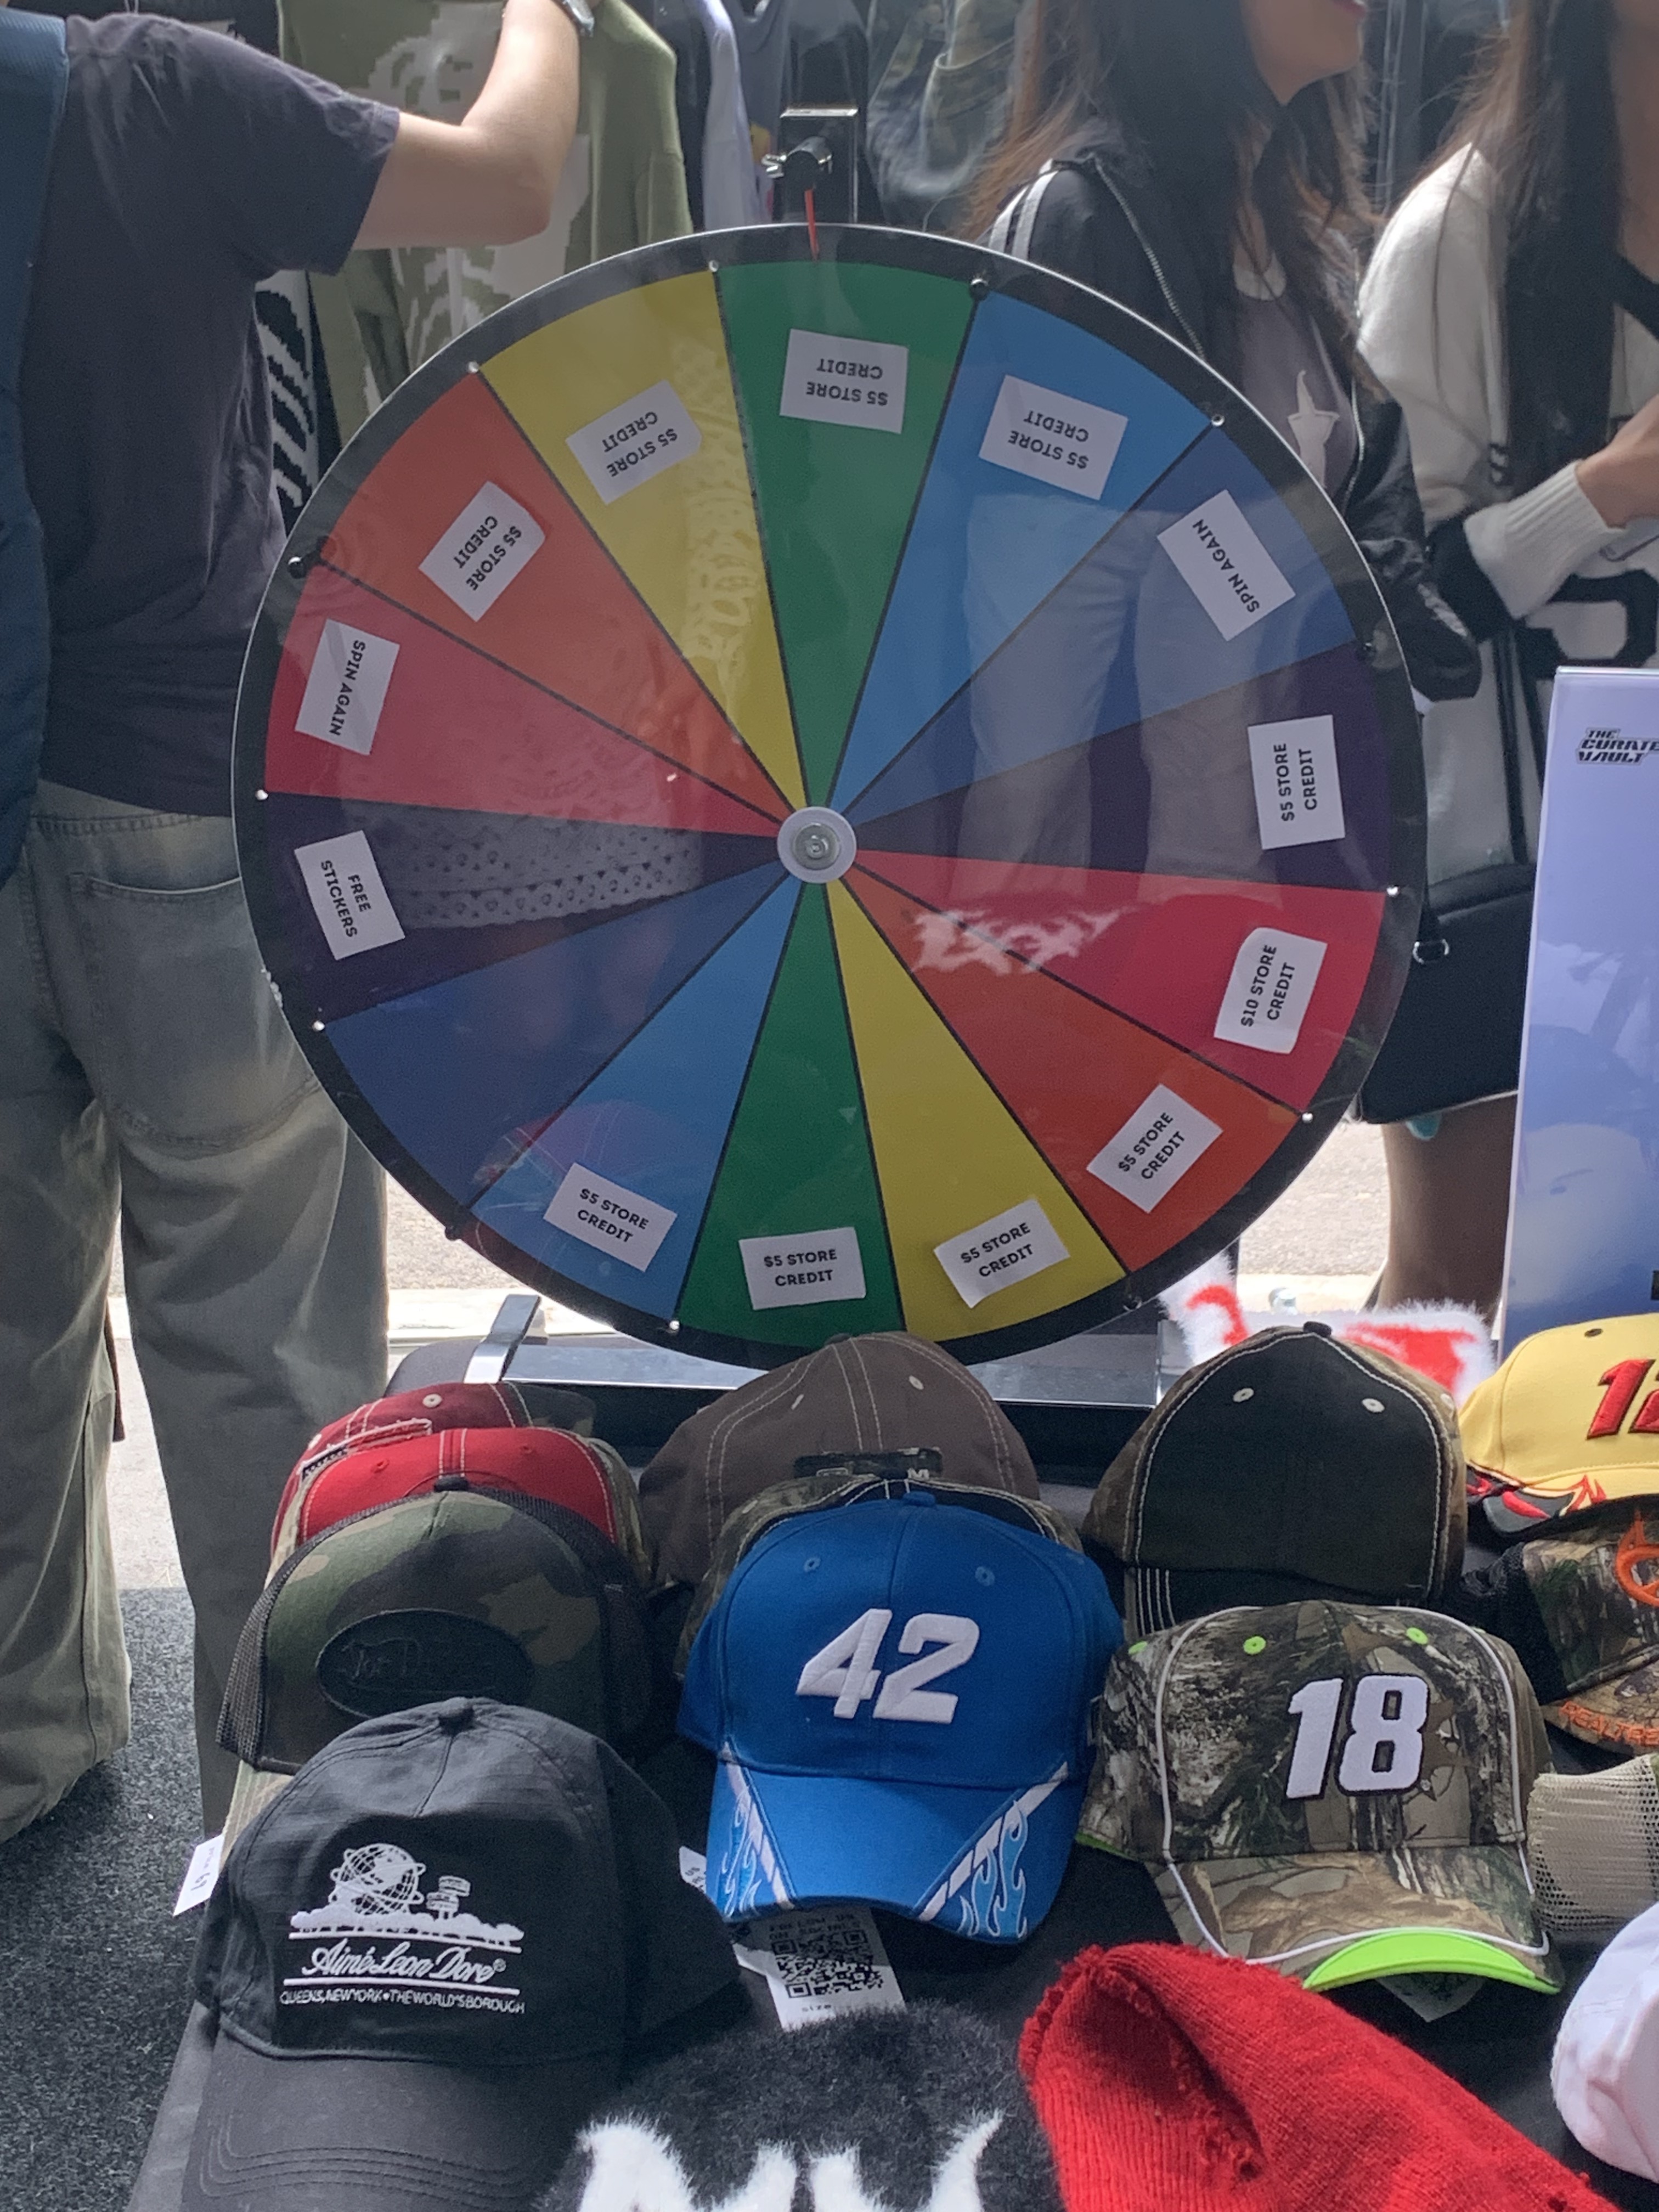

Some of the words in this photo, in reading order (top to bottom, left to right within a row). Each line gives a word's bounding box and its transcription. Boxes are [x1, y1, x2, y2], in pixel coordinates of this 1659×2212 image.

[816, 358, 883, 380] CREDIT
[806, 381, 862, 402] STORE
[867, 391, 888, 406] $5
[602, 411, 658, 453] CREDIT
[657, 428, 678, 447] $5
[1008, 430, 1063, 460] STORE
[1023, 410, 1089, 442] CREDIT
[606, 441, 657, 477] STORE
[1066, 452, 1089, 469] $5
[453, 516, 498, 569] CREDIT
[503, 526, 522, 547] $5
[1192, 519, 1235, 571] AGAIN
[466, 545, 506, 591] STORE
[1228, 573, 1260, 613] SPIN
[344, 640, 366, 680] SPIN
[329, 682, 353, 736] AGAIN
[1588, 730, 1618, 738] THE
[1273, 743, 1291, 797] STORE
[1578, 752, 1645, 763] VAULT
[1298, 748, 1317, 810] CREDIT
[1280, 802, 1295, 821] $5
[321, 860, 358, 938] STICKERS
[348, 874, 371, 912] FREE
[1240, 999, 1259, 1027] $10
[1250, 945, 1277, 996] STORE
[1267, 962, 1295, 1020] CREDIT
[1118, 1154, 1137, 1172] $5
[1133, 1112, 1173, 1156] STORE
[1141, 1131, 1185, 1180] CREDIT
[578, 1209, 634, 1243] CREDIT
[579, 1188, 599, 1204] $5
[601, 1200, 649, 1230] STORE
[764, 1255, 783, 1268] $5
[787, 1249, 837, 1266] STORE
[961, 1247, 980, 1263] $5
[981, 1222, 1031, 1252] STORE
[979, 1244, 1033, 1277] CREDIT
[775, 1269, 833, 1286] CREDIT
[795, 1608, 980, 1724] 42
[1285, 1674, 1430, 1799] 18
[369, 1942, 434, 1977] Leon
